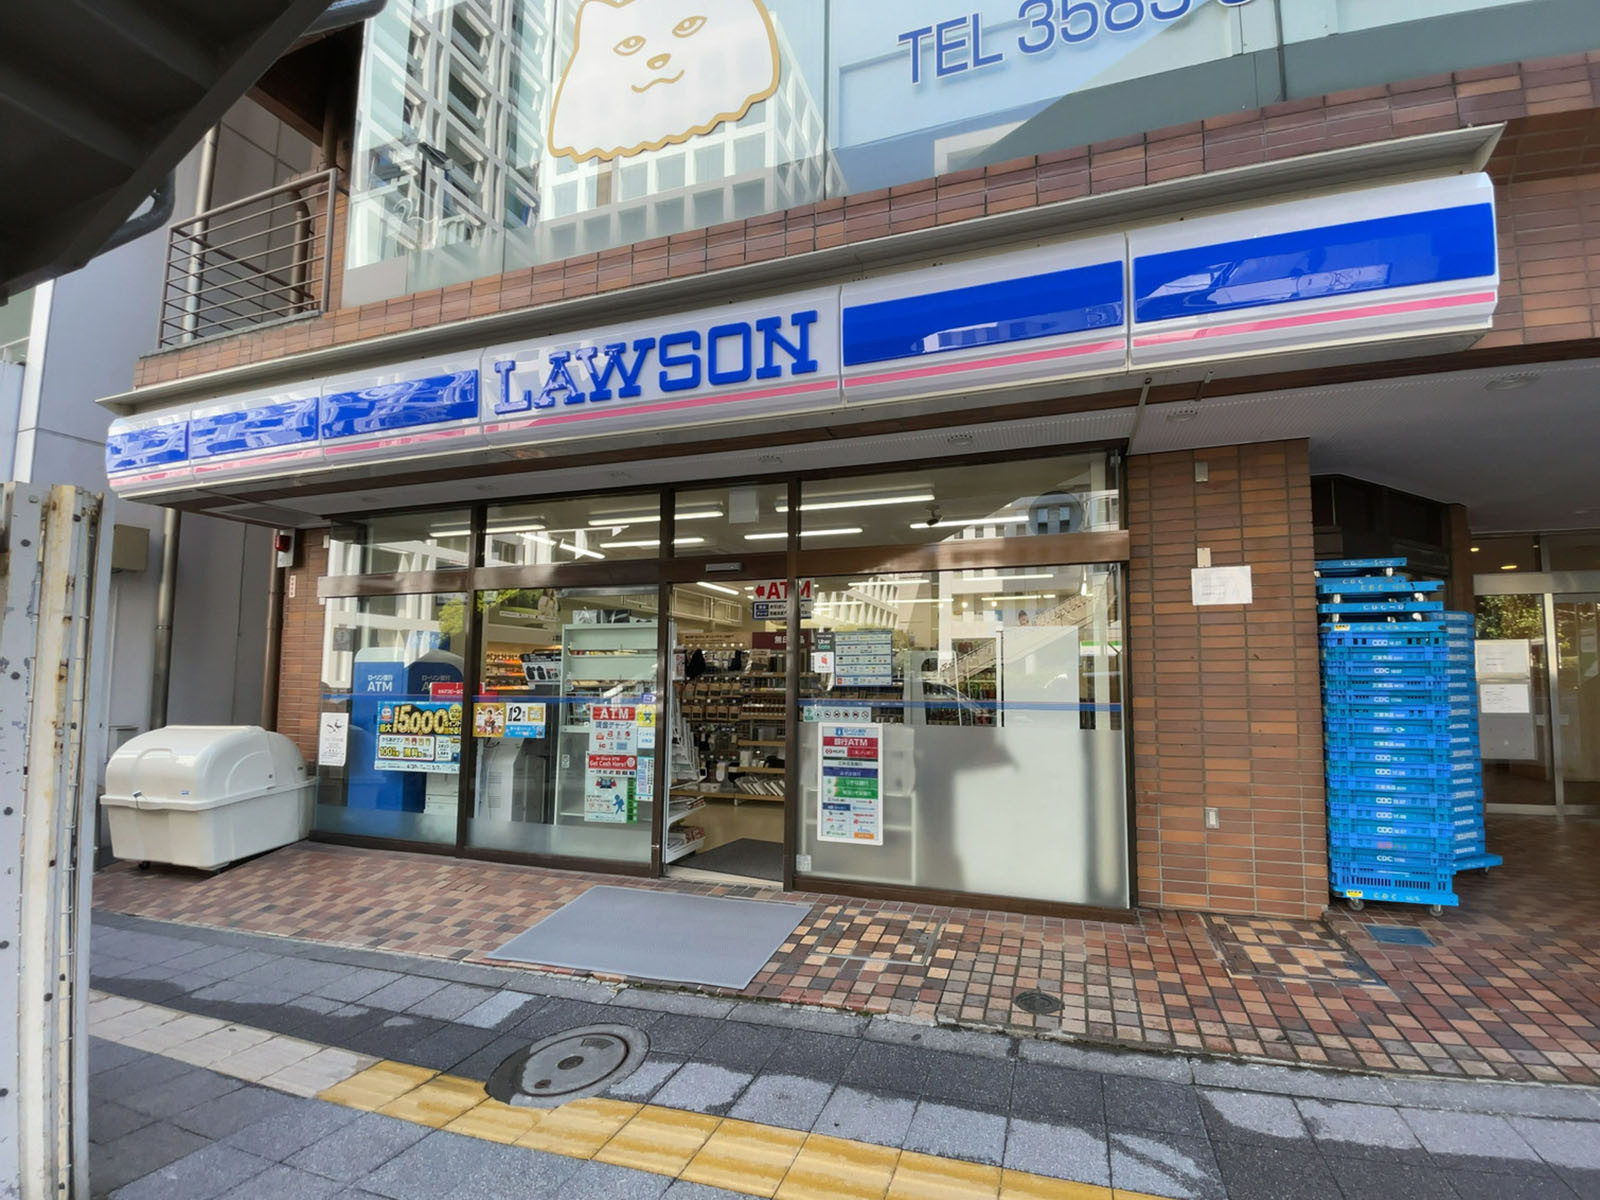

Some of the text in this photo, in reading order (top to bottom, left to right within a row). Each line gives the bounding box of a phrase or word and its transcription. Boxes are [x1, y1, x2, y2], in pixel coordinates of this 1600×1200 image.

[898, 13, 1003, 85] TEL
[493, 309, 819, 416] LAWSON
[367, 681, 393, 692] ATM
[600, 707, 629, 719] ATM
[834, 738, 868, 747] 銀行ATM
